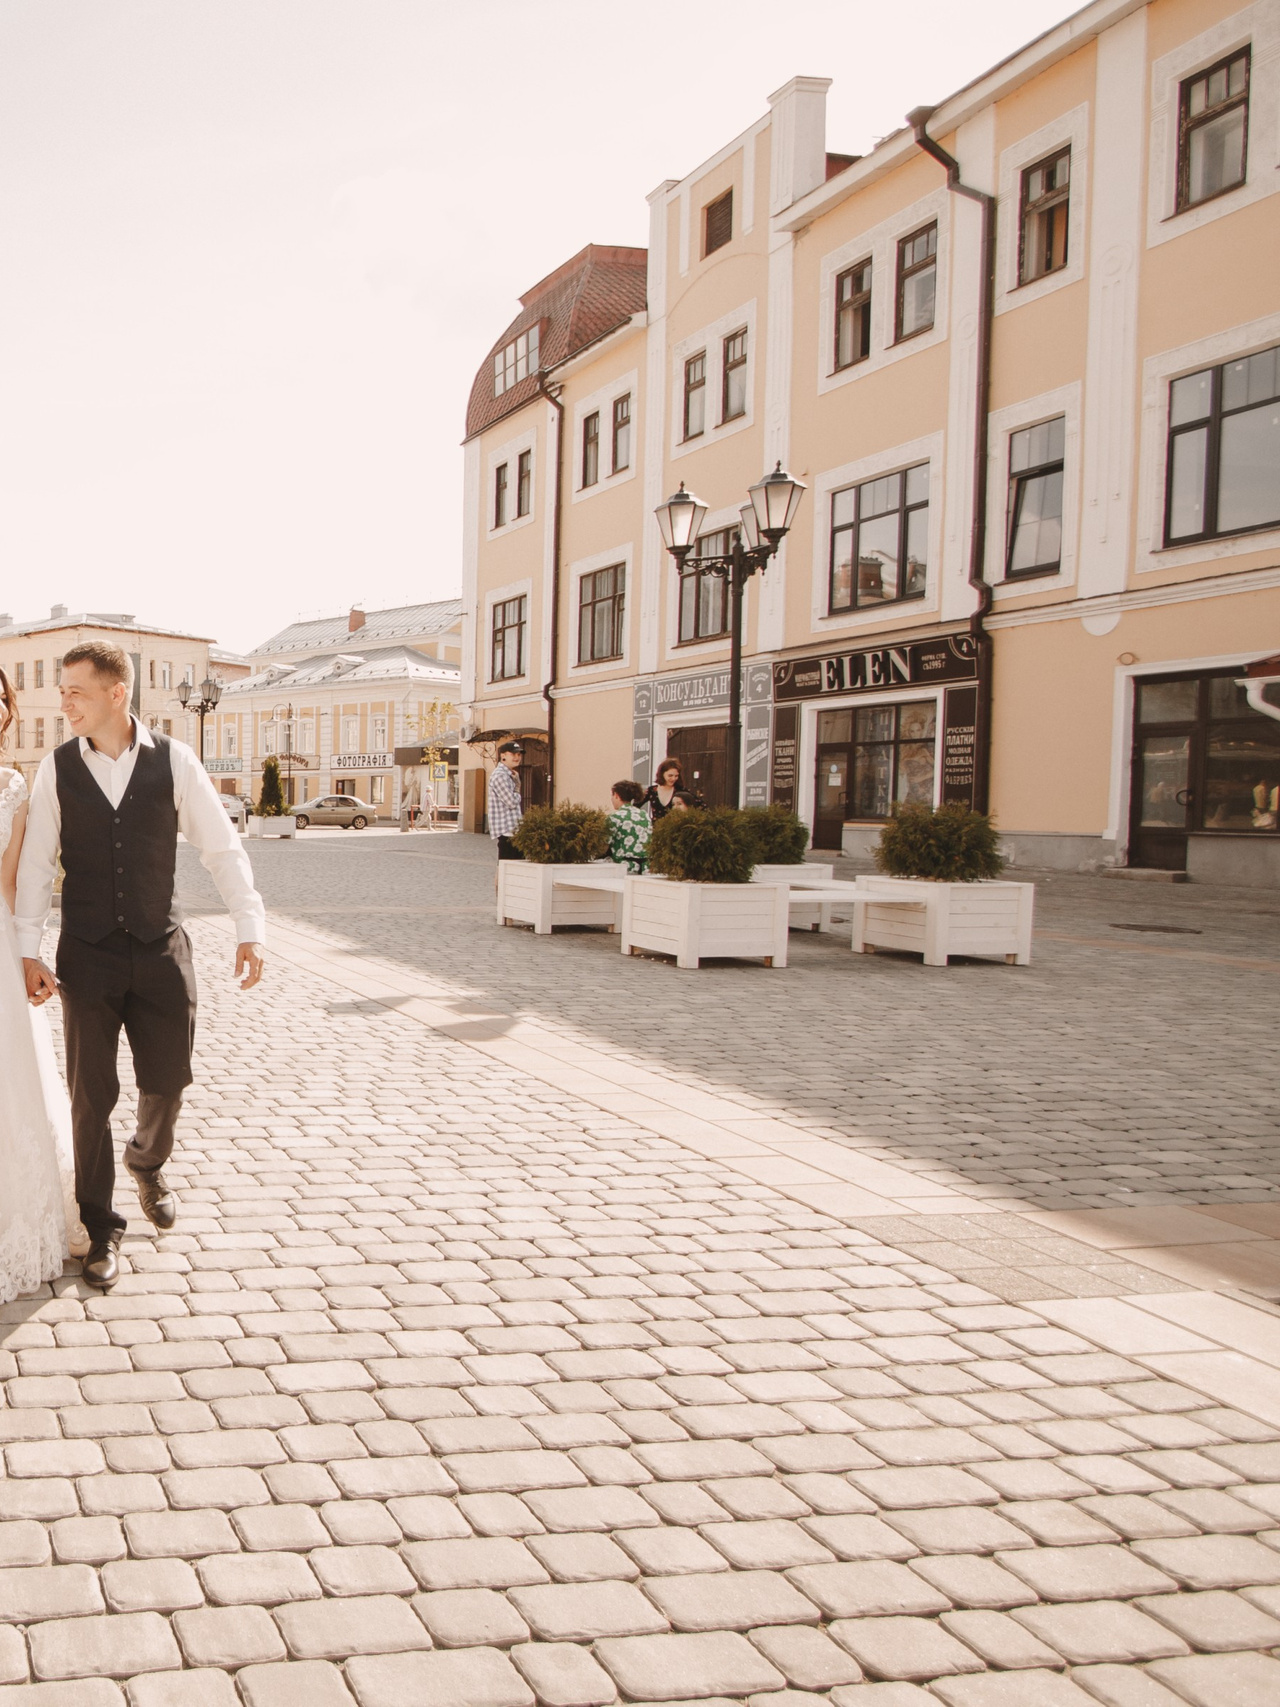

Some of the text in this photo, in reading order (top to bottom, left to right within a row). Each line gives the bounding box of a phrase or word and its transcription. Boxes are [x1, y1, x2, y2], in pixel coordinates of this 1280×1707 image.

[961, 642, 968, 653] 4
[819, 646, 912, 692] ELEN
[756, 683, 763, 693] 4
[946, 735, 974, 746] ПЛАТКИ
[945, 756, 973, 766] ОДЕЖДА
